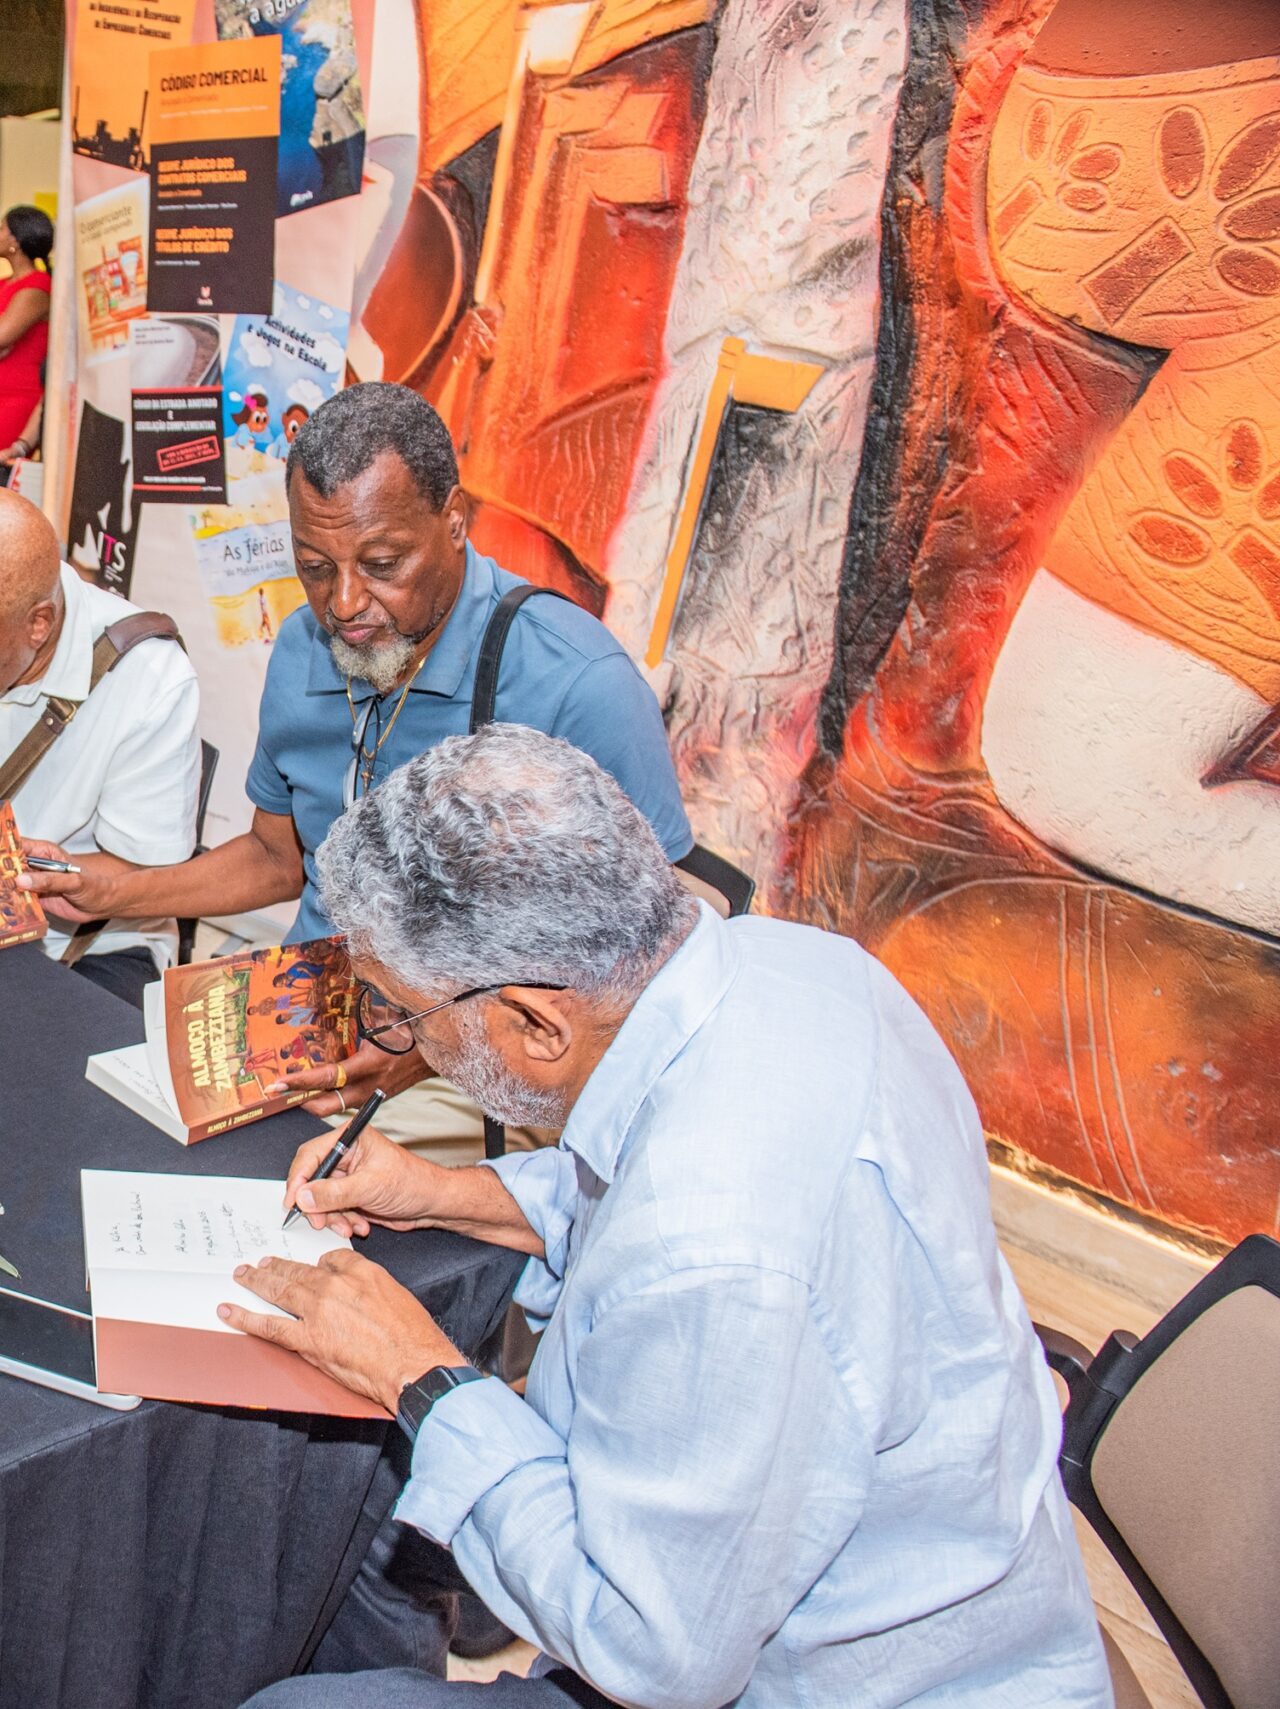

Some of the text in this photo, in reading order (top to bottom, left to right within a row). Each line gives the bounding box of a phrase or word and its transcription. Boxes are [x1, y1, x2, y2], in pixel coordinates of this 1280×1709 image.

[199, 67, 268, 88] COMERCIAL
[297, 347, 328, 372] Escola
[224, 544, 242, 561] As
[182, 998, 212, 1088] ALMOÇO À
[208, 984, 233, 1092] ZAMBEZIANA
